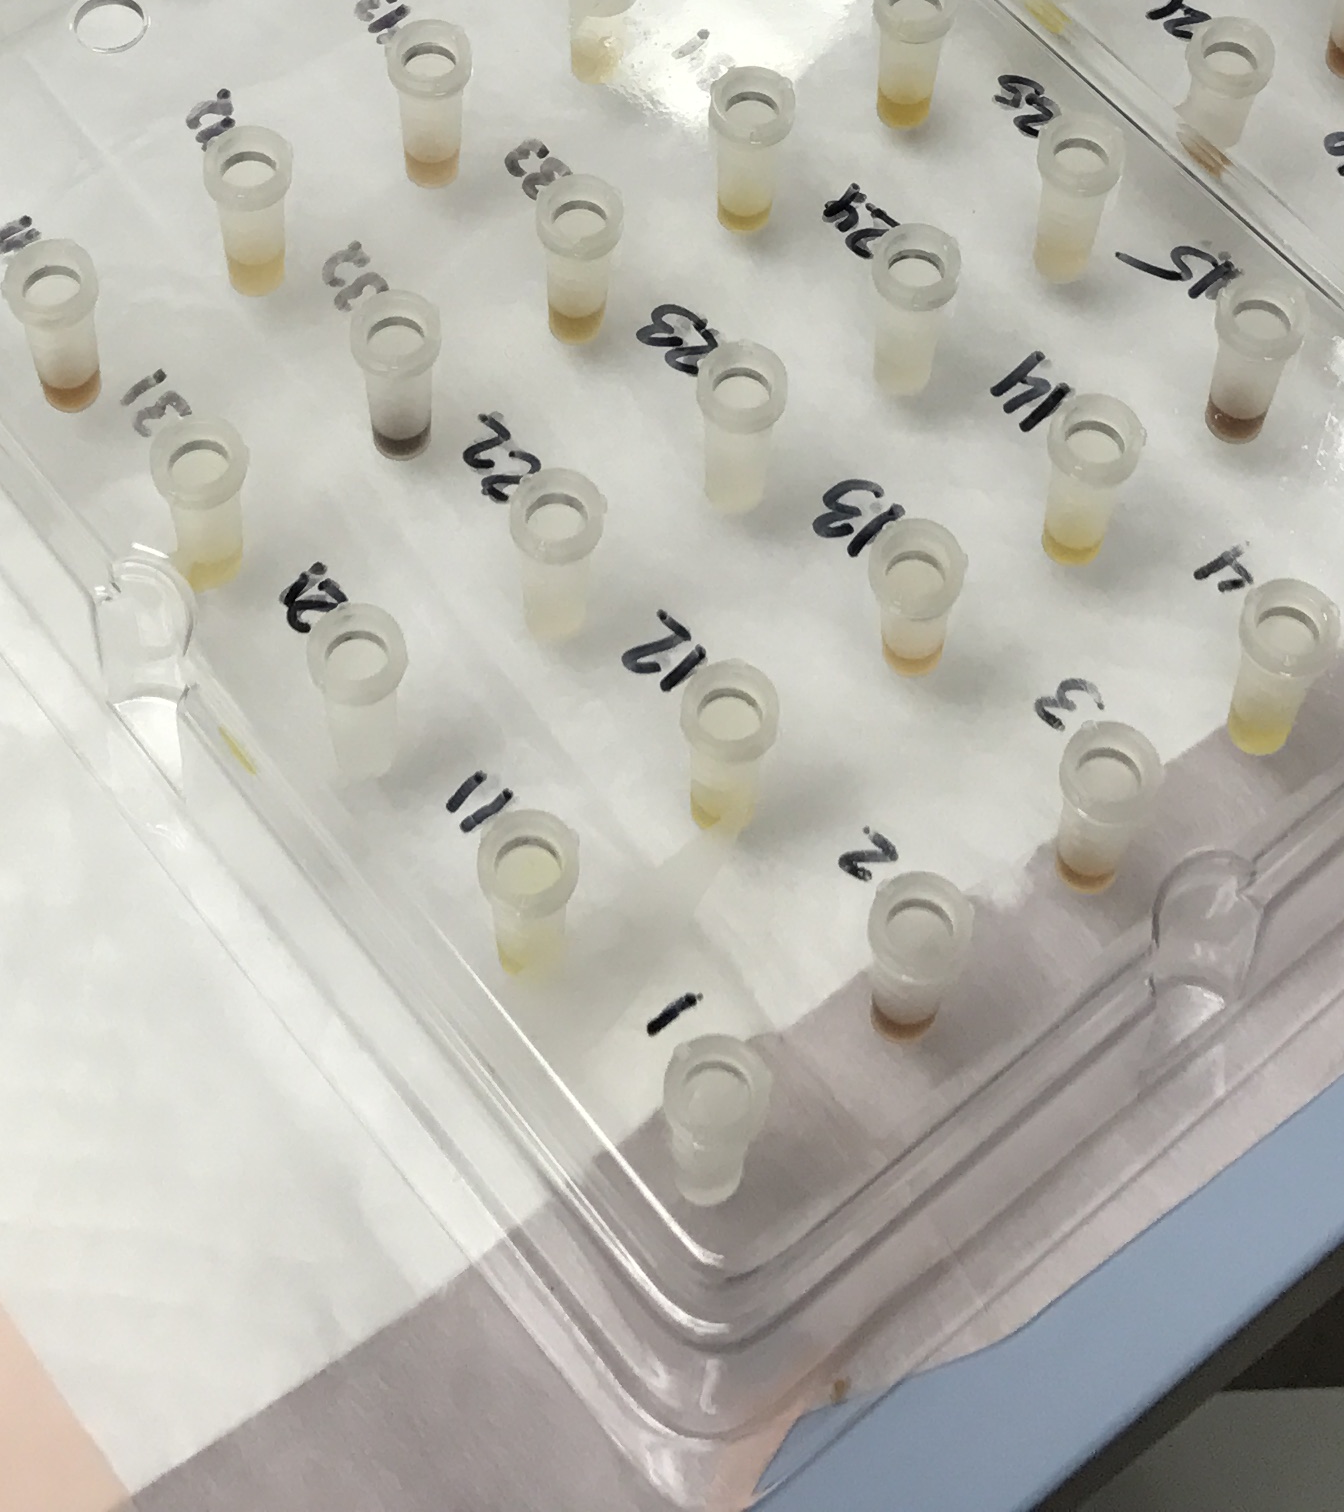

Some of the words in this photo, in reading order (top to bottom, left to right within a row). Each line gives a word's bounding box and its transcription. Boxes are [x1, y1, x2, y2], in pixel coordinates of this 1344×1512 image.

[992, 74, 1061, 138] 25
[504, 139, 573, 200] 33
[822, 182, 901, 260] 24
[322, 241, 389, 312] 32
[1114, 245, 1243, 299] 15
[636, 303, 718, 376] 23
[120, 368, 192, 437] 31
[990, 350, 1075, 432] 14
[462, 411, 541, 503] 22
[812, 479, 906, 558] 13
[621, 609, 706, 691] 12
[1034, 677, 1105, 732] 3
[446, 770, 513, 833] 11
[838, 826, 899, 882] 2
[646, 992, 704, 1037] 1
